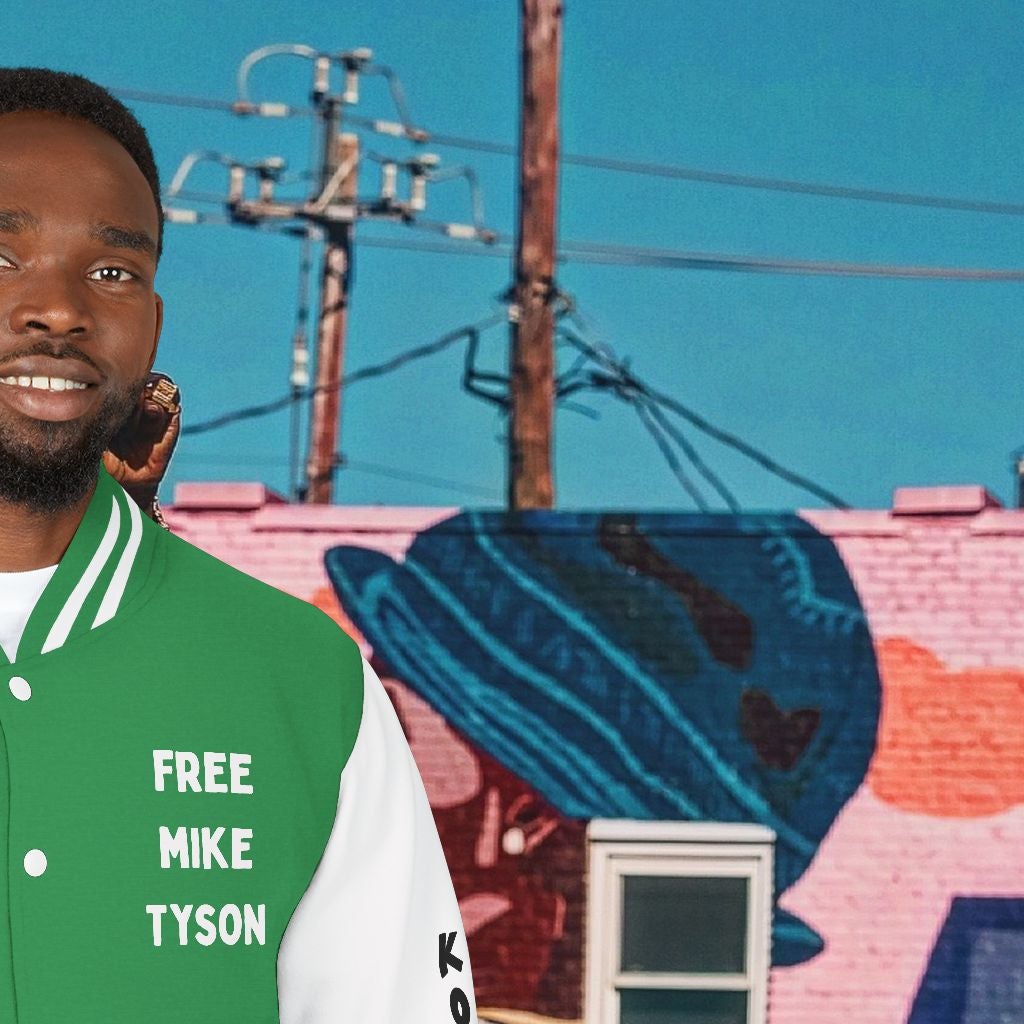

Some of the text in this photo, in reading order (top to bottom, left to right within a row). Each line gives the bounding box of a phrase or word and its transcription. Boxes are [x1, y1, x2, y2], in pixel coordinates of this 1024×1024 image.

[153, 750, 254, 794] FREE
[159, 826, 253, 869] MIKE
[146, 904, 266, 946] TYSON
